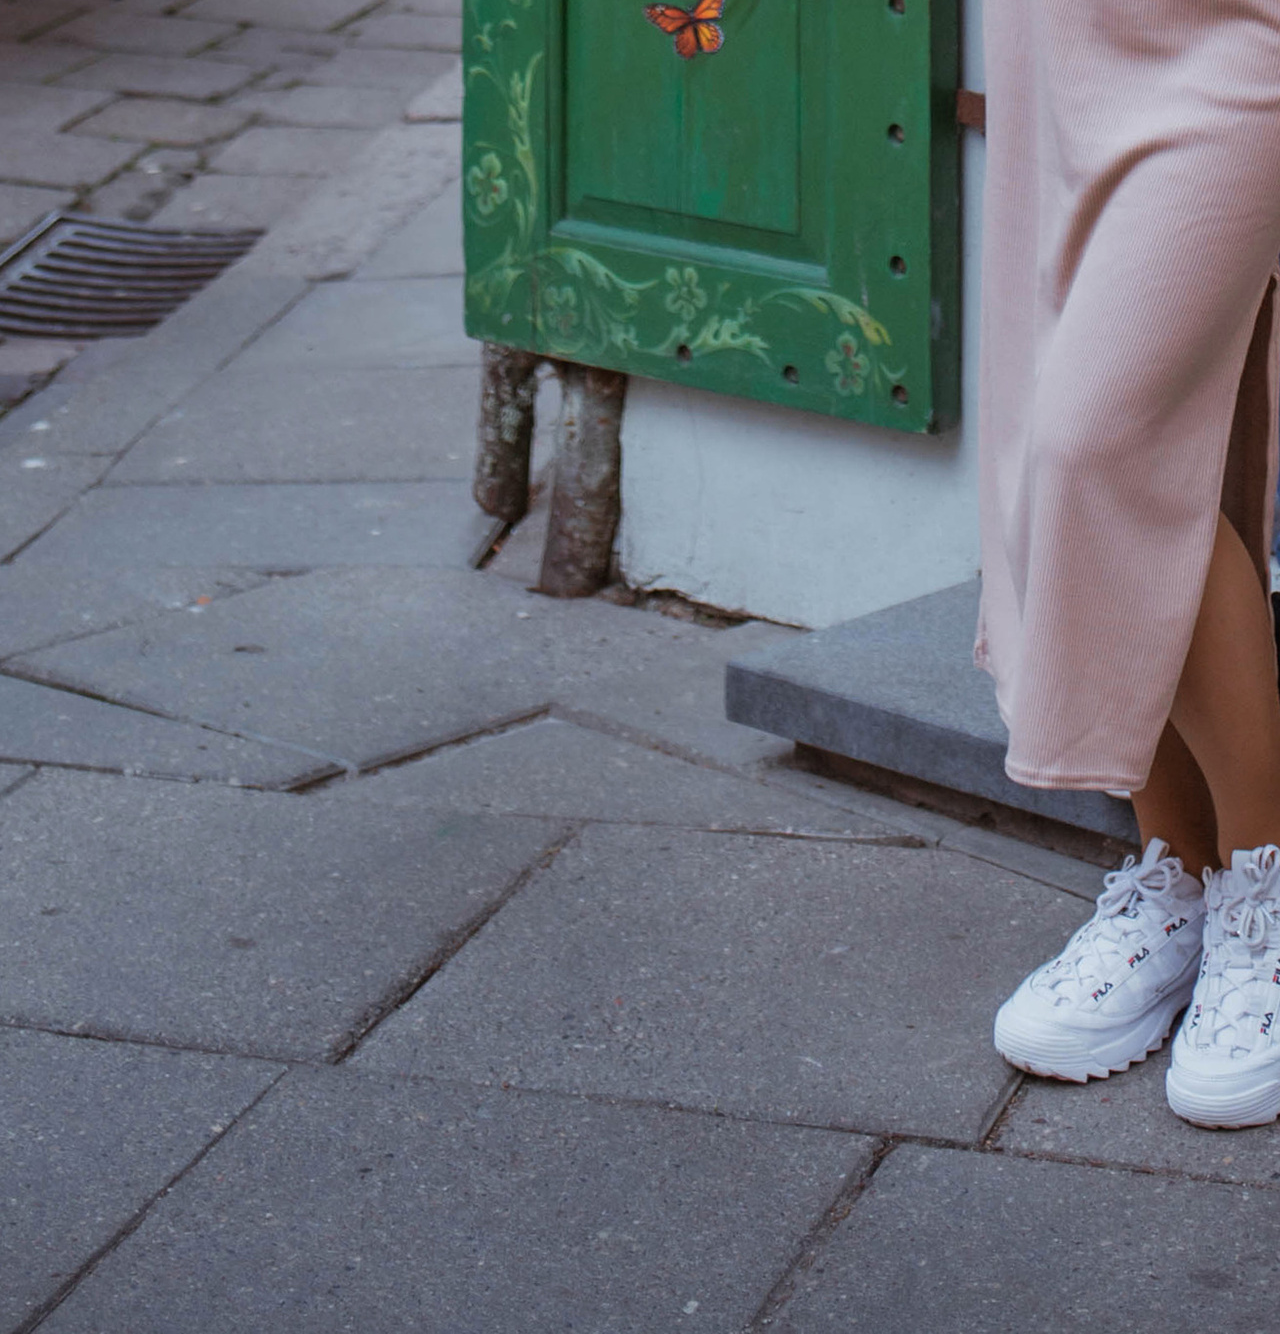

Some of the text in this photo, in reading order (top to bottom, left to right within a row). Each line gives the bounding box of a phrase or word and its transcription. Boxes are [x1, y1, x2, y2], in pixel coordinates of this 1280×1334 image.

[1164, 917, 1188, 937] FILA
[1127, 947, 1150, 969] FILA
[1091, 982, 1114, 1002] FILA
[1260, 1012, 1274, 1036] FILA
